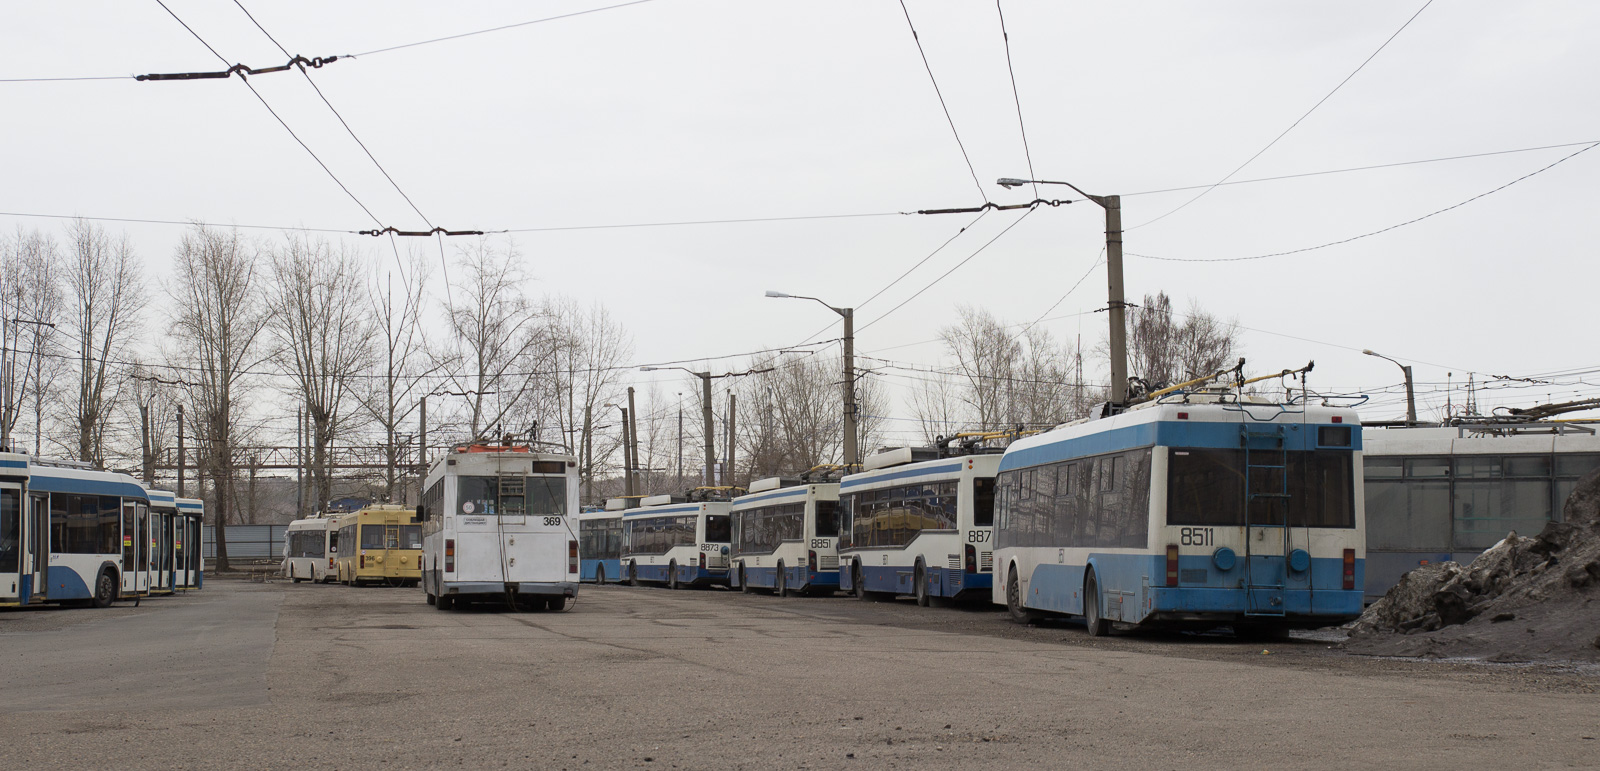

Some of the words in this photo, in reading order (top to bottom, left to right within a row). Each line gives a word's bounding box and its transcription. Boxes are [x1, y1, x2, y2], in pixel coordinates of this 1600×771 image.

[543, 517, 561, 526] 369
[968, 530, 993, 542] 887
[1181, 528, 1213, 546] 8511
[811, 539, 830, 549] 8851
